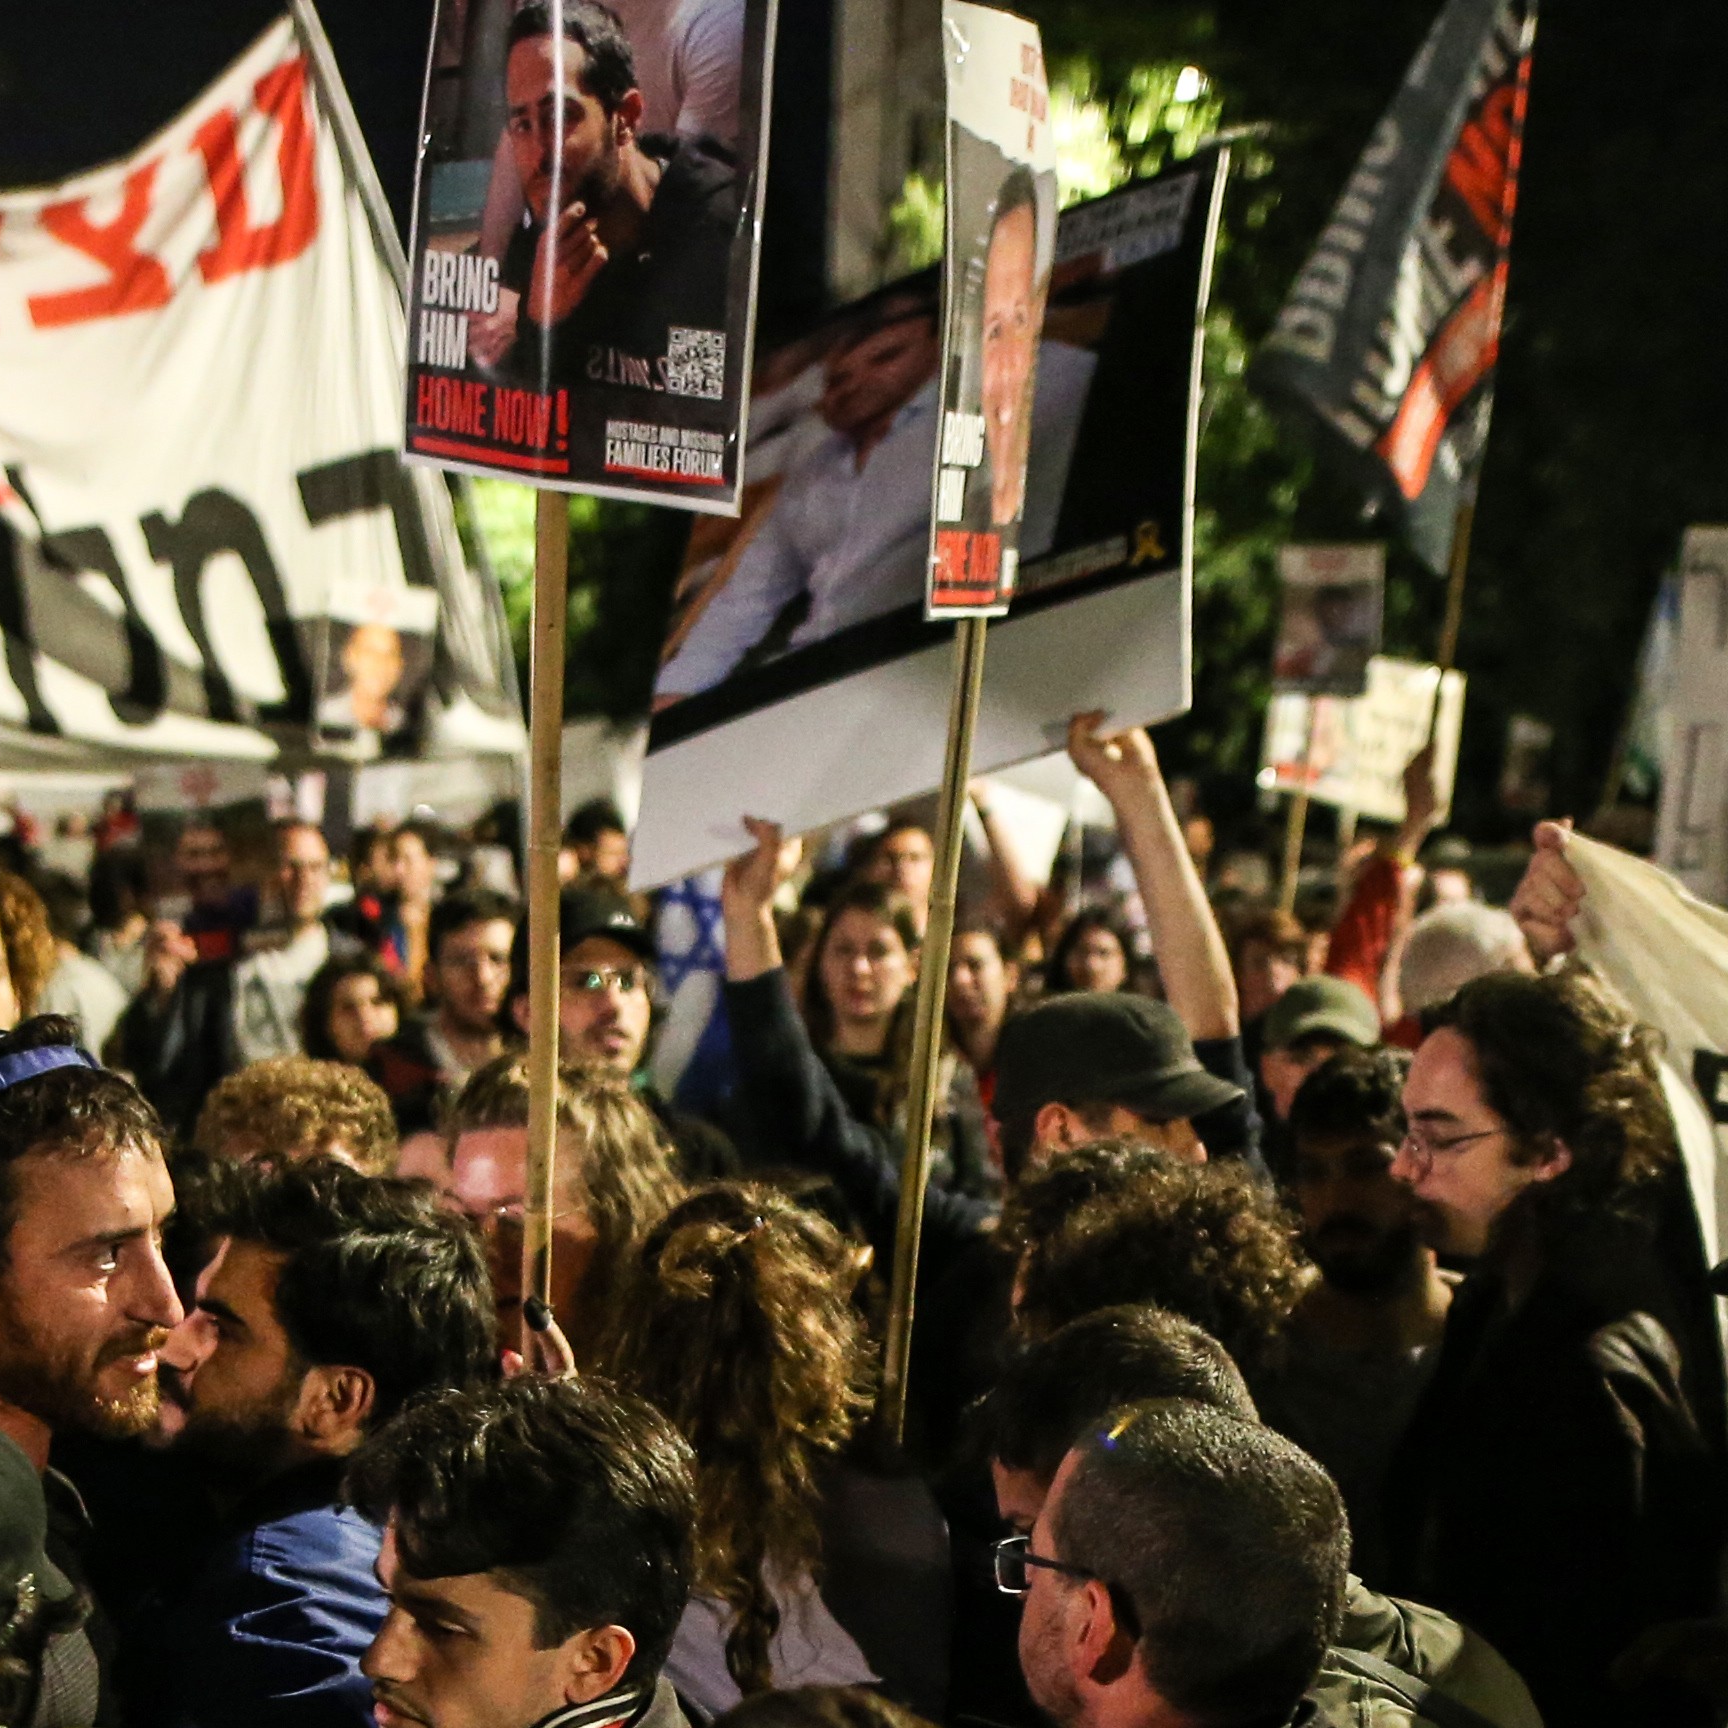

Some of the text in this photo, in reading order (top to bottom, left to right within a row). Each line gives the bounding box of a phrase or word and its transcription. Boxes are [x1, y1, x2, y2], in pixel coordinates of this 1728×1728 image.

[422, 250, 501, 313] BRING
[418, 307, 470, 370] HIM
[416, 374, 570, 451] HOME NOW!
[605, 438, 723, 479] FAMILIES FORUM
